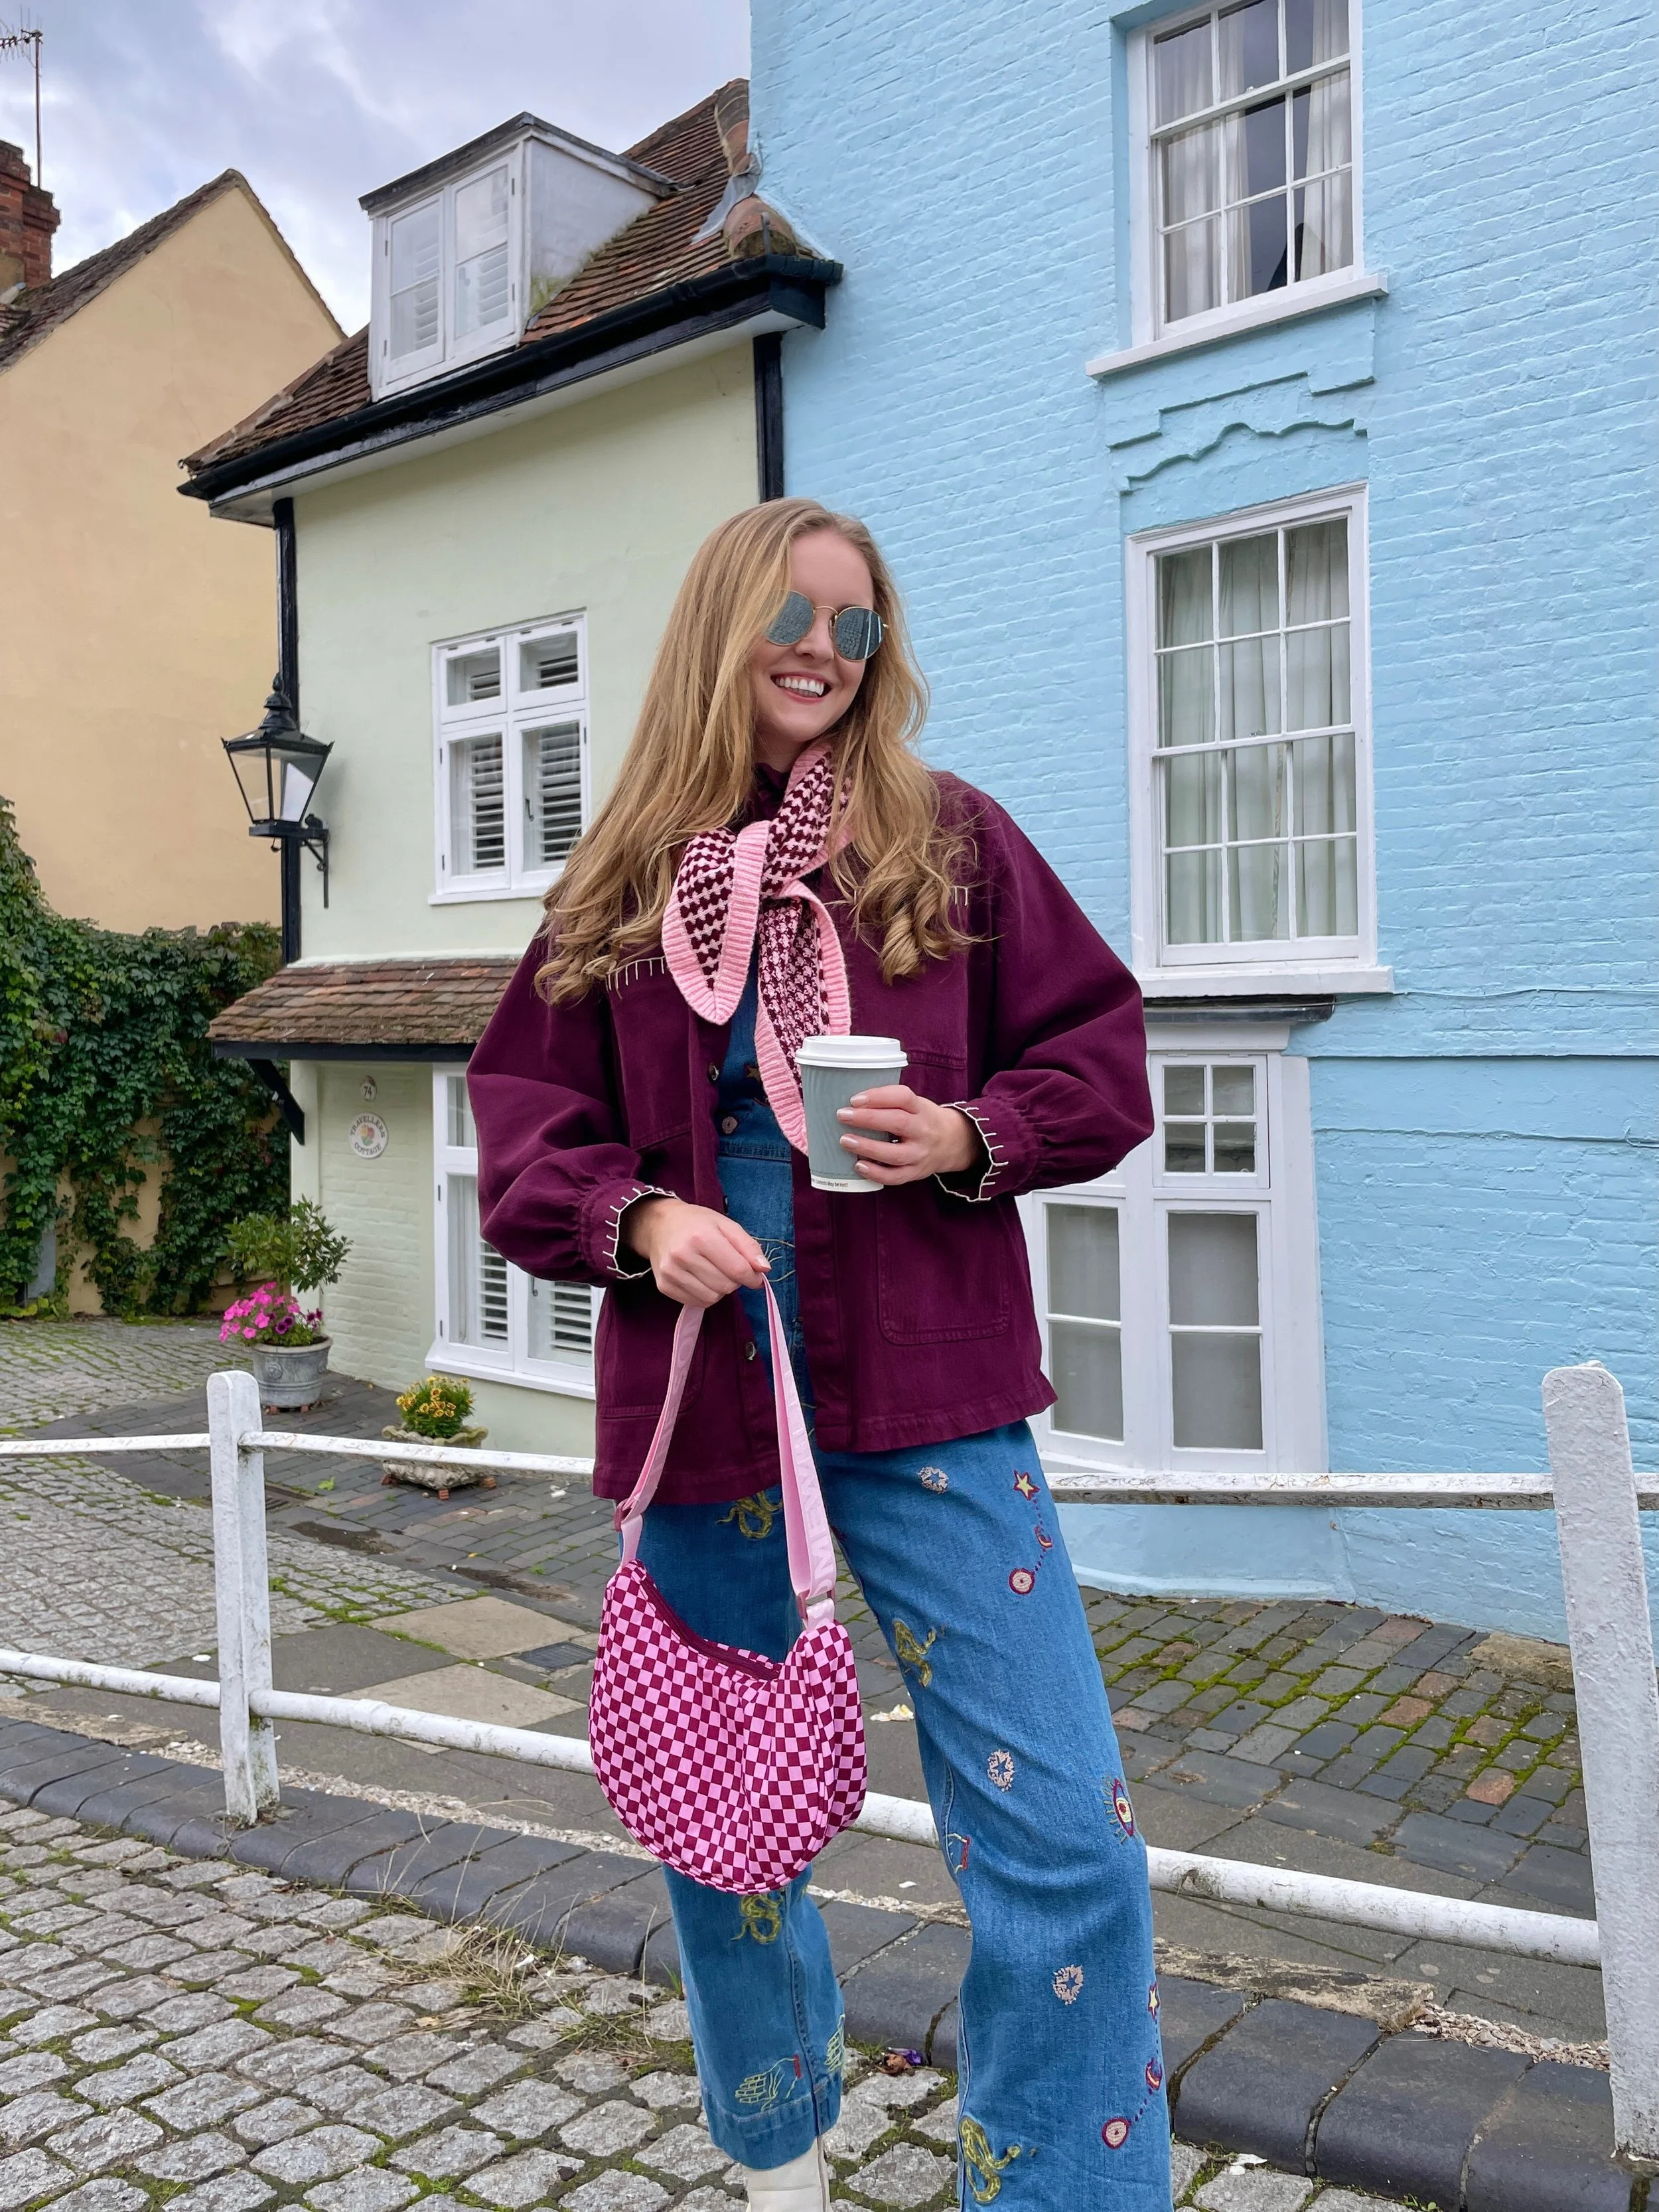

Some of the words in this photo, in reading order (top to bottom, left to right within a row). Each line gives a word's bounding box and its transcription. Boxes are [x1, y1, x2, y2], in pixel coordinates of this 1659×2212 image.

[363, 1086, 372, 1098] 74
[350, 1115, 386, 1138] TRAVELLERS
[354, 1142, 382, 1155] COTTAGE
